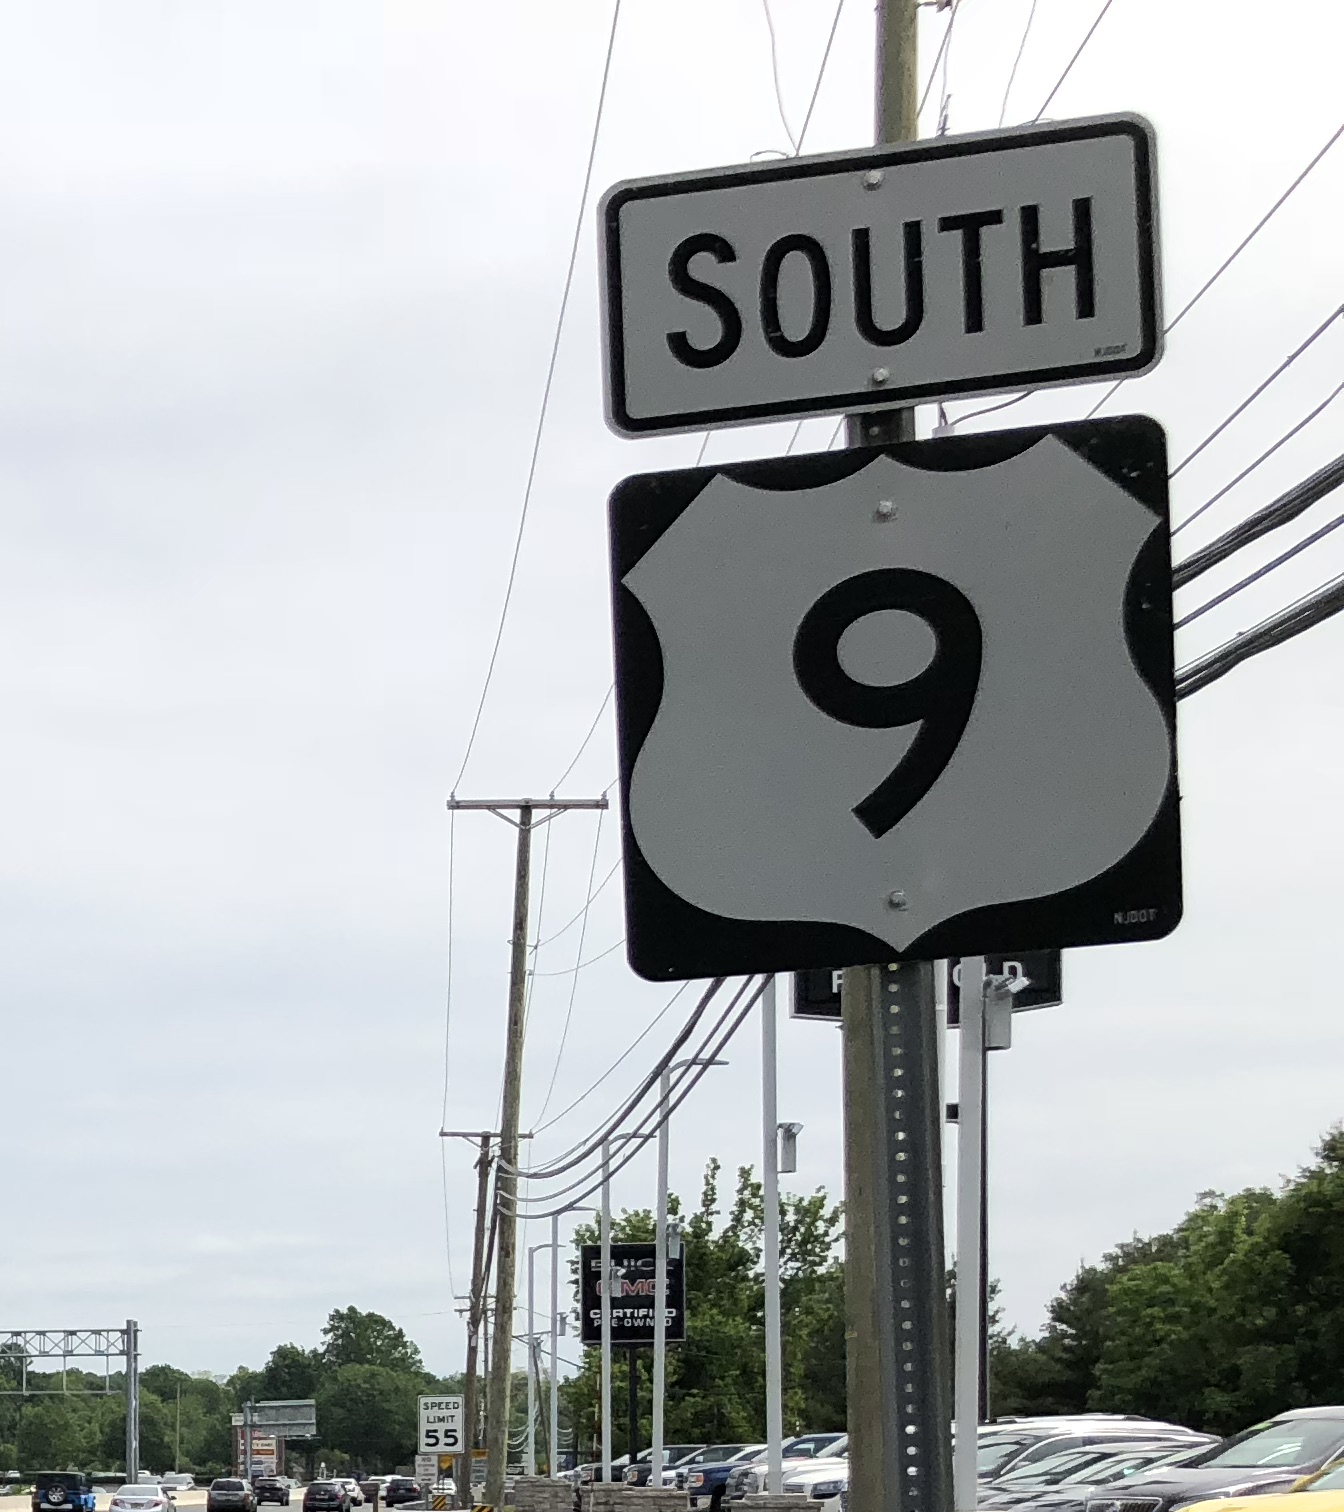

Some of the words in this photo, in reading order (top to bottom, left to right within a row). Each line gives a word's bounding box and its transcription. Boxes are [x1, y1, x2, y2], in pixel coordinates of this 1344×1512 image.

[665, 196, 1096, 369] SOUTH
[792, 567, 983, 839] 9
[590, 1258, 674, 1271] BUIC
[589, 1308, 677, 1318] CRTIFID
[593, 1318, 672, 1327] PE-OWND
[422, 1401, 460, 1411] SPEED
[426, 1415, 456, 1424] LIMIT
[424, 1428, 459, 1447] 55
